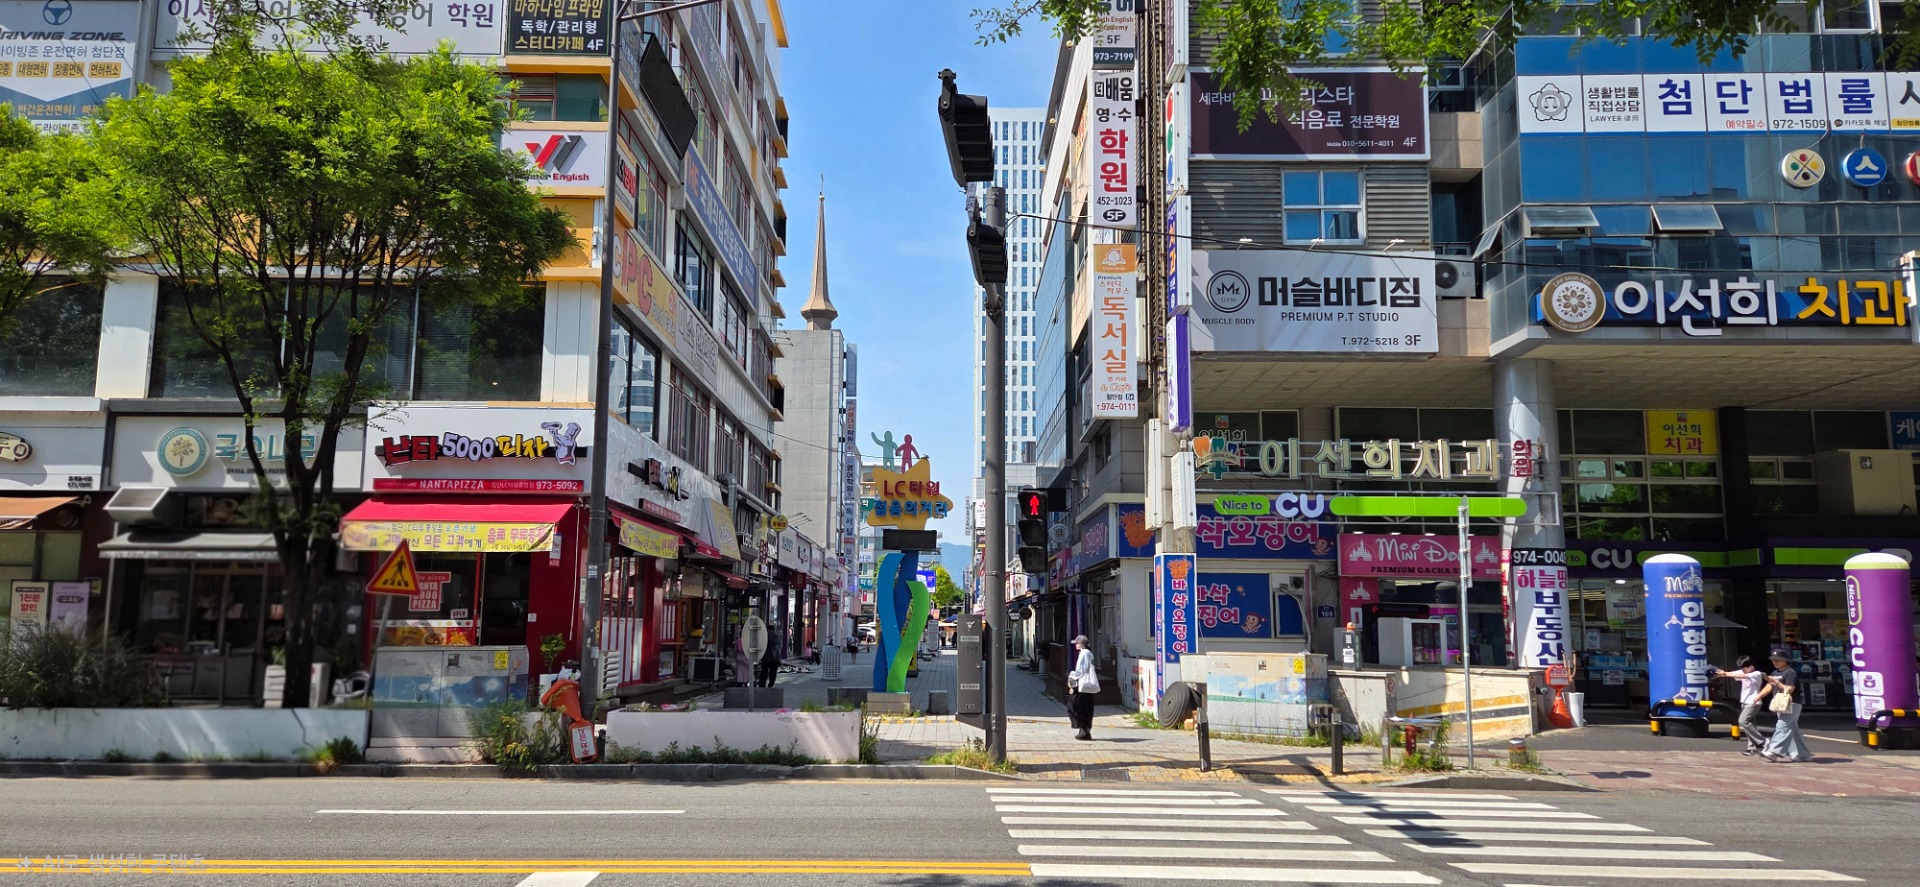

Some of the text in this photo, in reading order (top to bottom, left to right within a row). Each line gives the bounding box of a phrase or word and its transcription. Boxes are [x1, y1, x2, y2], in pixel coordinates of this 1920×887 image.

[447, 3, 494, 28] 학원
[521, 20, 597, 34] 독학/관리형
[69, 31, 126, 41] ZONE
[515, 36, 604, 50] 스터디카페 4F
[1107, 35, 1120, 44] 5F
[42, 45, 87, 57] 운전면허
[92, 46, 125, 58] 첨단점
[91, 64, 120, 75] 면허취소
[1588, 87, 1639, 99] 생활법률
[1588, 101, 1640, 112] 직접상담
[1096, 107, 1132, 122] 영·수
[1288, 110, 1400, 129] 식음료 전문학원
[1725, 119, 1765, 129] 예약필수
[1773, 119, 1826, 129] 972-1509
[1403, 137, 1418, 147] 4F
[1099, 128, 1129, 193] 학원
[553, 174, 589, 182] English
[1097, 197, 1133, 206] 452-1023
[1106, 212, 1122, 221] 5F
[1258, 277, 1421, 308] 머슬바디짐
[1613, 276, 1911, 337] 이선희 치과
[1281, 312, 1334, 322] PREMIUM
[1359, 312, 1399, 322] STUDIO
[1101, 296, 1128, 375] 독서실
[1341, 334, 1421, 346] T.972-5218 3F
[1663, 423, 1702, 436] 이선희
[1664, 437, 1704, 454] 치과
[419, 480, 484, 491] NANTAPIZZA
[536, 481, 578, 491] 973-5092
[883, 480, 940, 497] LC타워
[1222, 500, 1263, 511] Nice to
[1275, 493, 1326, 518] CU
[487, 527, 506, 544] 음료
[1196, 514, 1322, 551] 삭오징어
[423, 534, 441, 548] 모든
[1591, 548, 1633, 569] CU
[1371, 566, 1478, 575] PREMIUM GACHA SP
[419, 582, 438, 590] ANTA
[413, 600, 437, 609] PIZZA
[1171, 579, 1188, 653] 바삭오징어
[1200, 606, 1240, 628] 징어
[1533, 591, 1564, 666] 부동산
[1850, 627, 1866, 667] CU
